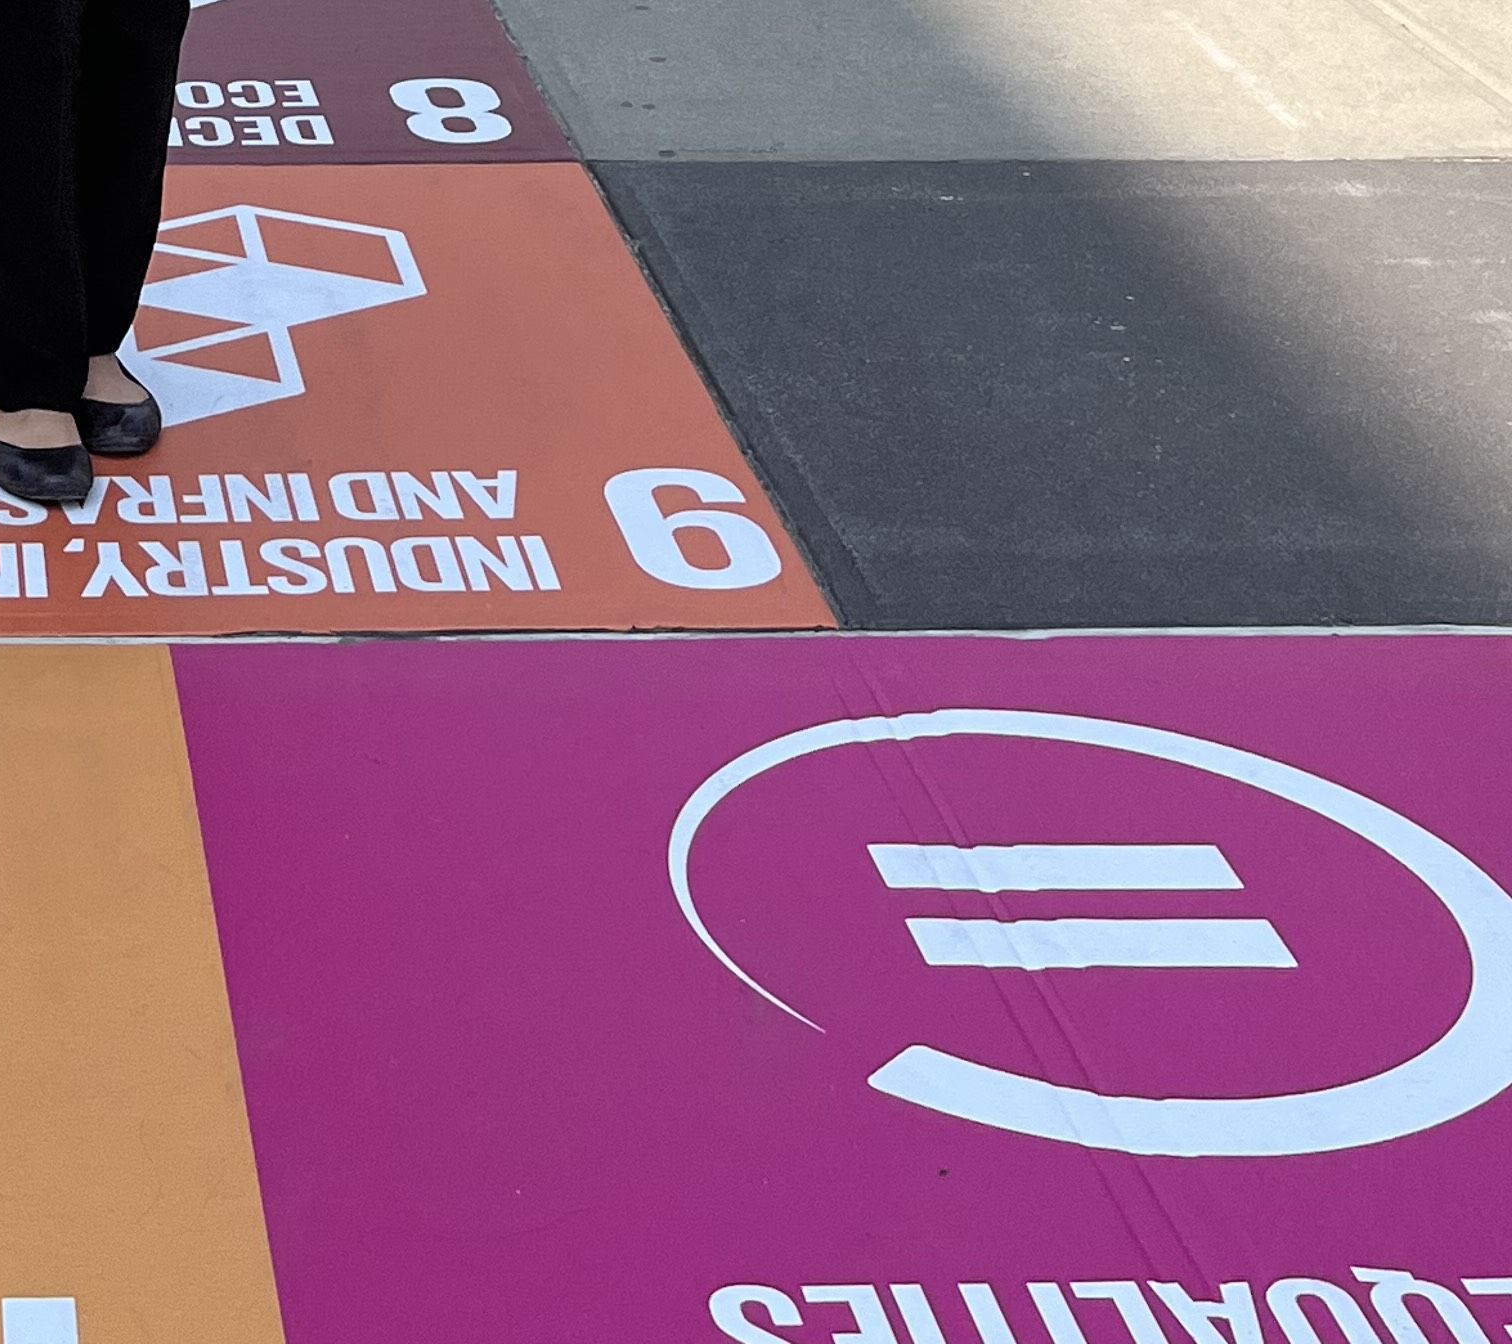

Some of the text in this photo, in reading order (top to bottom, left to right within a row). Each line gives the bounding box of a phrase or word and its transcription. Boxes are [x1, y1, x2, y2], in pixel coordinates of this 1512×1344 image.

[389, 77, 513, 144] 8
[327, 469, 518, 521] AND
[603, 467, 783, 591] 9
[63, 534, 563, 598] INDUSTRY,
